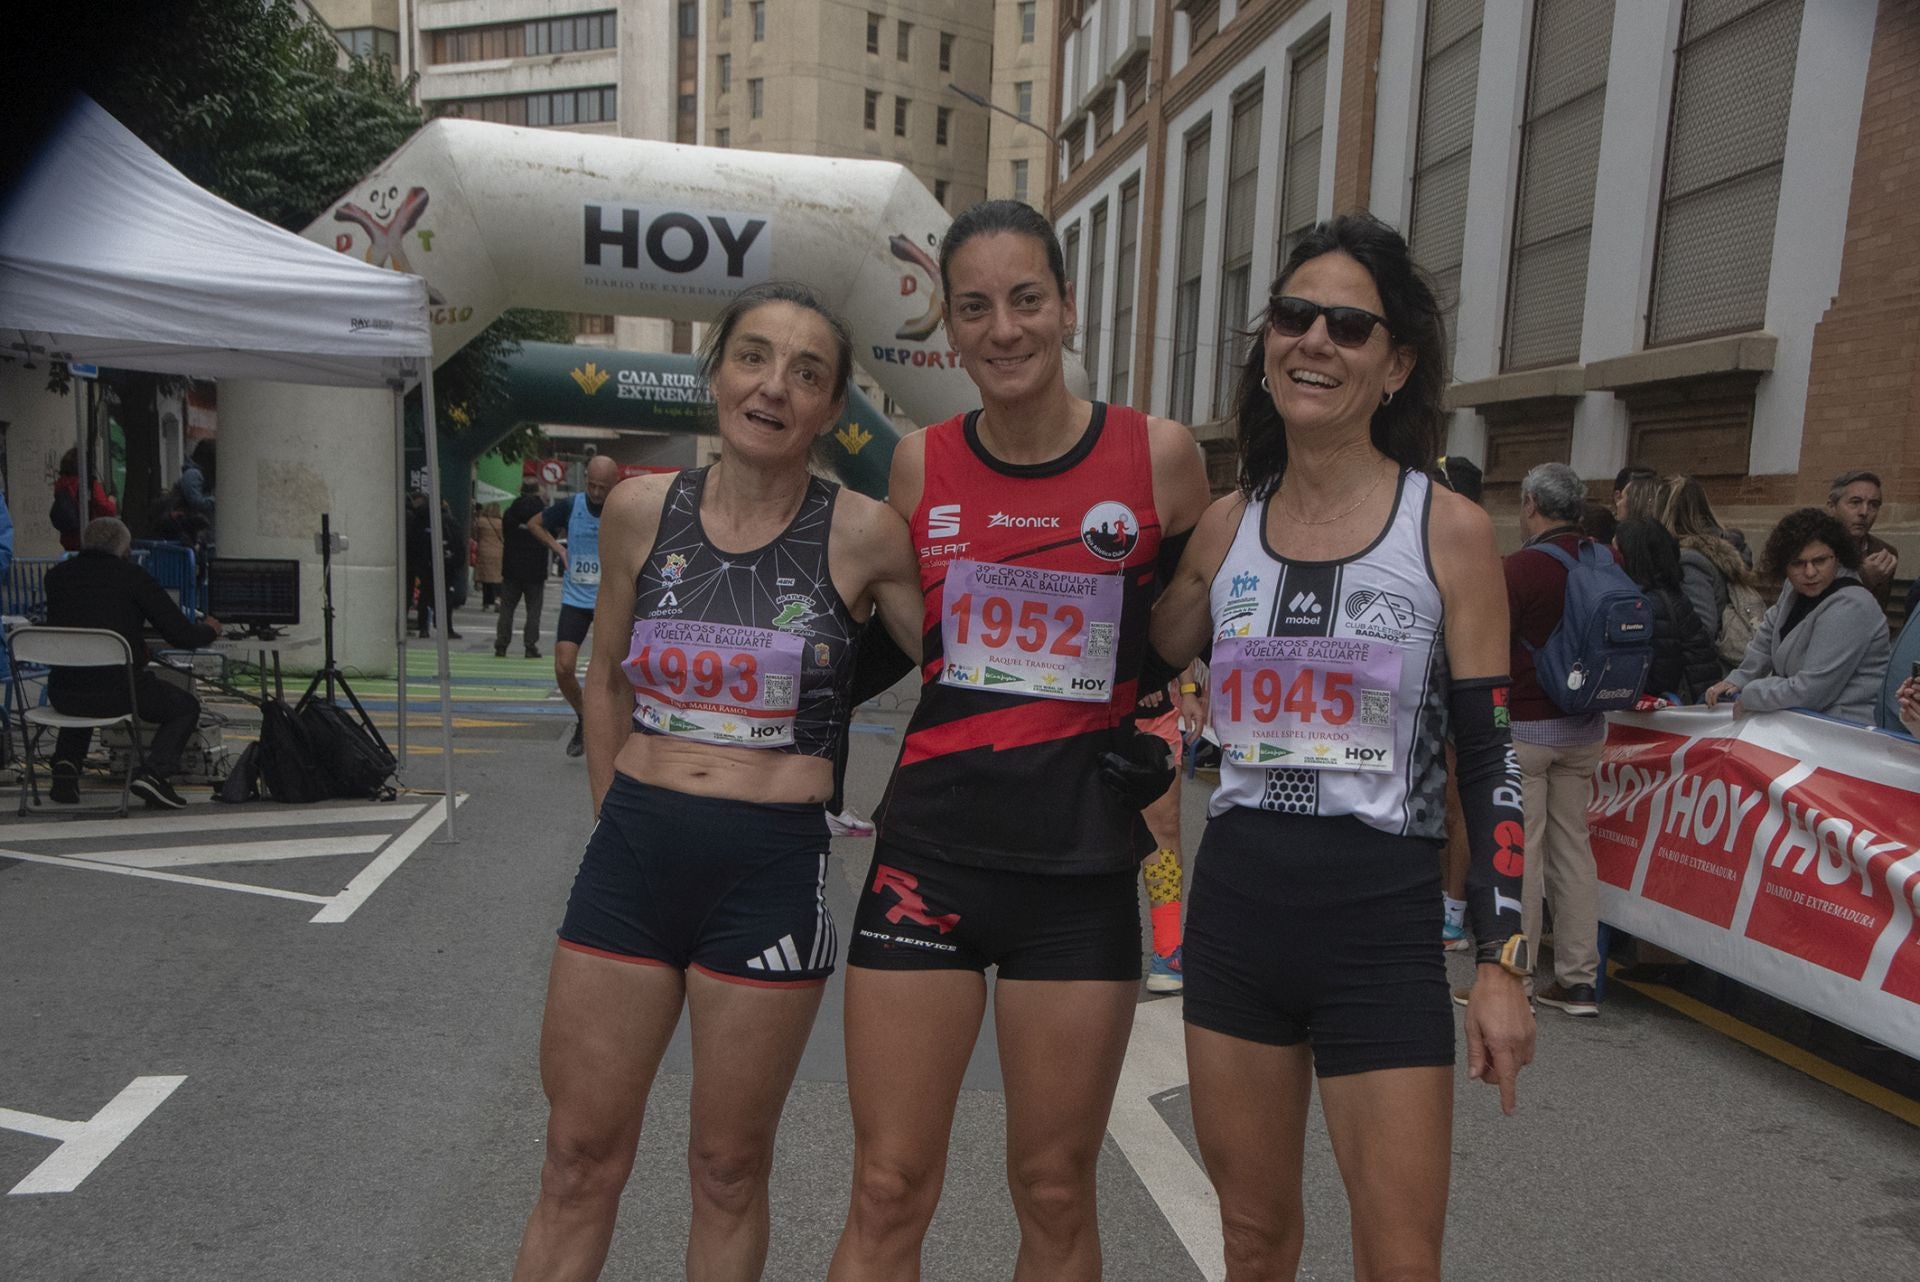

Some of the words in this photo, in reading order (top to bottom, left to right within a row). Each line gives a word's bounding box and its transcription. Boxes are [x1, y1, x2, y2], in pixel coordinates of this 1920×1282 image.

[584, 205, 767, 278] HOY
[585, 277, 634, 290] DIARIO
[639, 281, 657, 291] DE
[662, 283, 743, 299] EXTREMAD
[617, 369, 659, 386] CAJA
[920, 541, 971, 558] SEAT
[975, 572, 1017, 587] VUELTA
[1021, 579, 1035, 590] AL
[1040, 580, 1097, 596] BALUARTE
[999, 567, 1039, 580] CROSS
[1043, 572, 1098, 585] POPULAR
[675, 622, 716, 634] CROSS
[720, 627, 774, 639] POPULAR
[951, 592, 1084, 658] 1952
[1345, 621, 1366, 630] CLUB
[654, 629, 693, 641] VUELTA
[696, 632, 711, 644] AL
[715, 634, 773, 649] BALUARTE
[1268, 640, 1308, 648] CROSS
[1312, 640, 1370, 651] POPULAR
[1355, 629, 1400, 643] BADAJOZ
[989, 655, 1022, 667] RAQUEL
[1024, 659, 1065, 671] TRABUCO
[1244, 647, 1284, 657] VUELTA
[1287, 647, 1302, 657] AL
[1307, 648, 1369, 661] BALUARTE
[631, 646, 758, 703] 1993
[1071, 678, 1107, 691] HOY
[1221, 668, 1355, 726] 1945
[718, 703, 748, 716] RAMOS
[751, 724, 786, 738] HOY
[1252, 730, 1280, 739] ISABEL
[1281, 730, 1305, 739] ESPEL
[1308, 731, 1349, 741] JURADO
[1345, 747, 1387, 762] HOY
[1588, 761, 1664, 822] HOY
[1665, 774, 1763, 853] HOY
[1599, 828, 1638, 848] EXTREMADURA
[1771, 801, 1908, 897] HOY
[1658, 847, 1680, 863] DIARIO
[1680, 854, 1689, 867] DE
[1689, 857, 1738, 881] EXTREMADURA
[1766, 882, 1793, 900] DIARIO
[1793, 891, 1804, 906] DE
[1806, 895, 1876, 928] EXTREMADURA
[860, 929, 890, 940] MOTO
[894, 936, 957, 952] SERVICE
